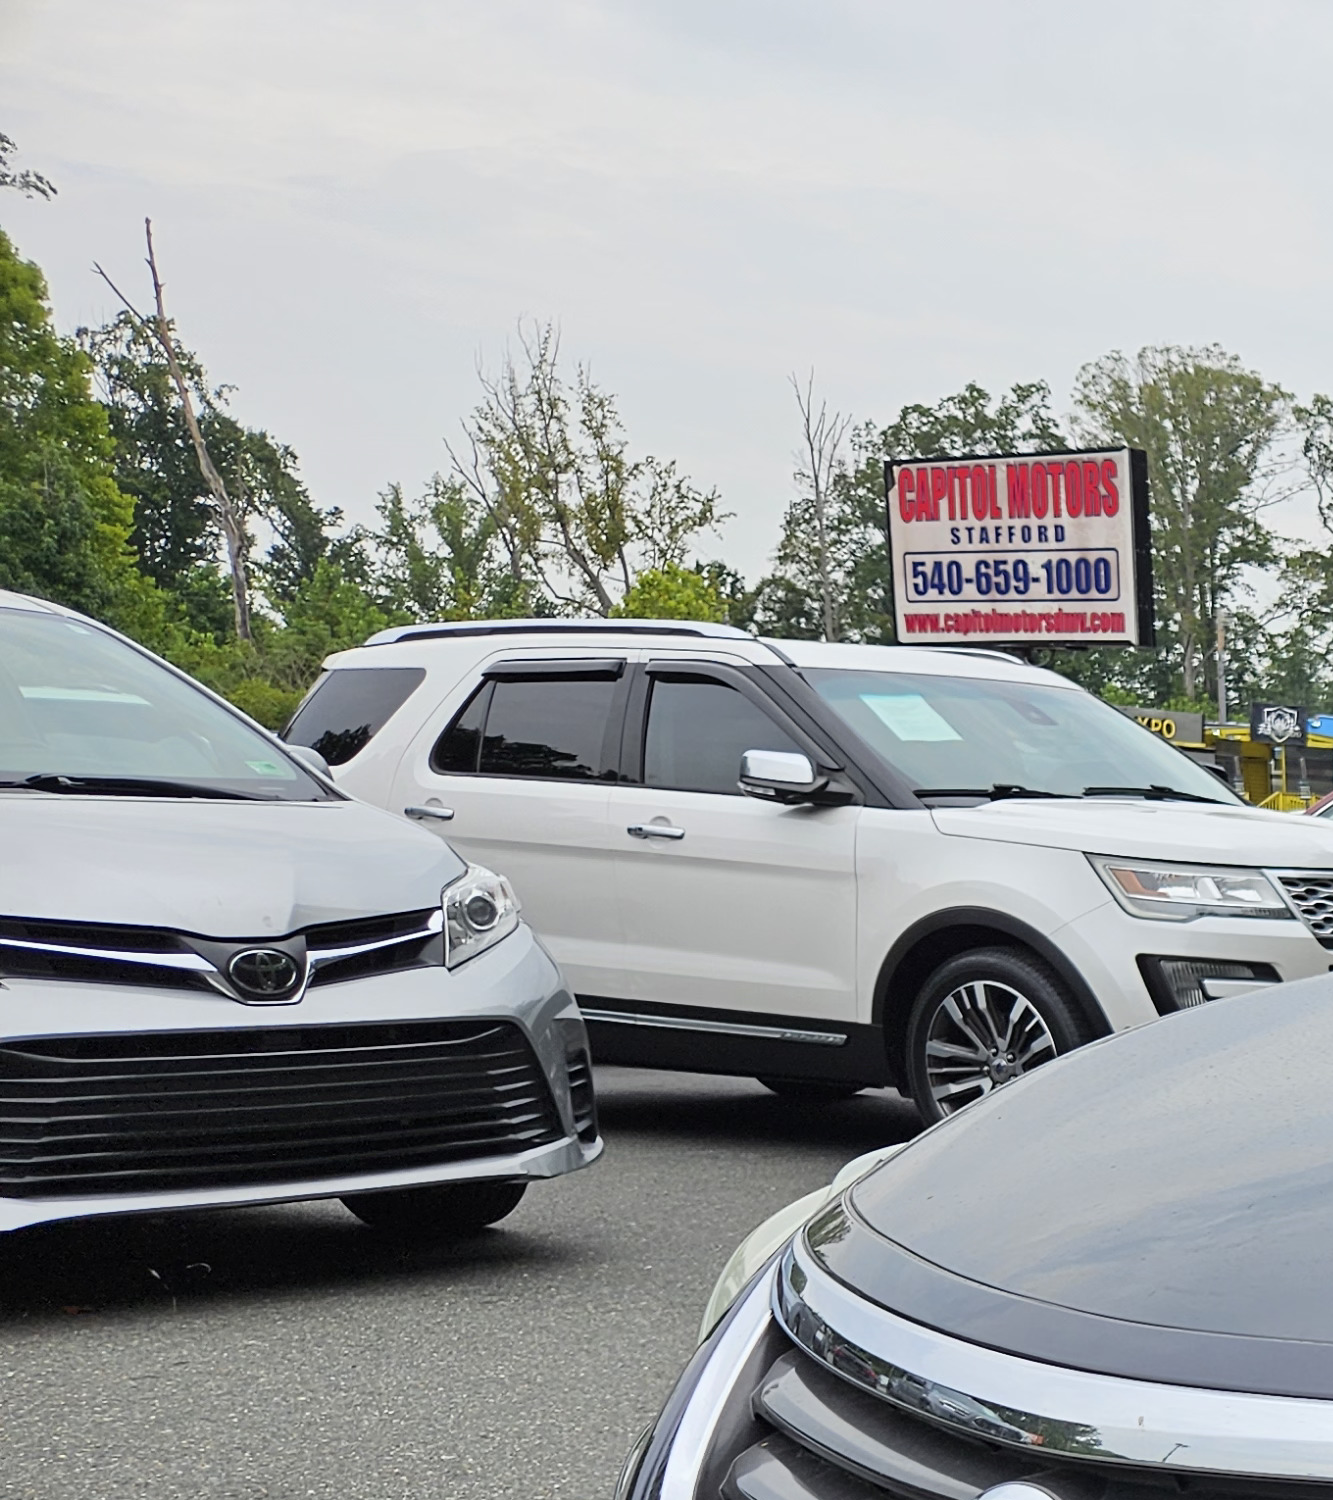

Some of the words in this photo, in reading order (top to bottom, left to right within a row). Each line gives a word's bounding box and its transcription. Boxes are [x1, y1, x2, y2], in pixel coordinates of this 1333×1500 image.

[898, 465, 1002, 523] CAPITOL
[1005, 459, 1119, 519] MOTORS
[950, 524, 1066, 545] STAFFORD
[911, 557, 1112, 596] 540-659-1000
